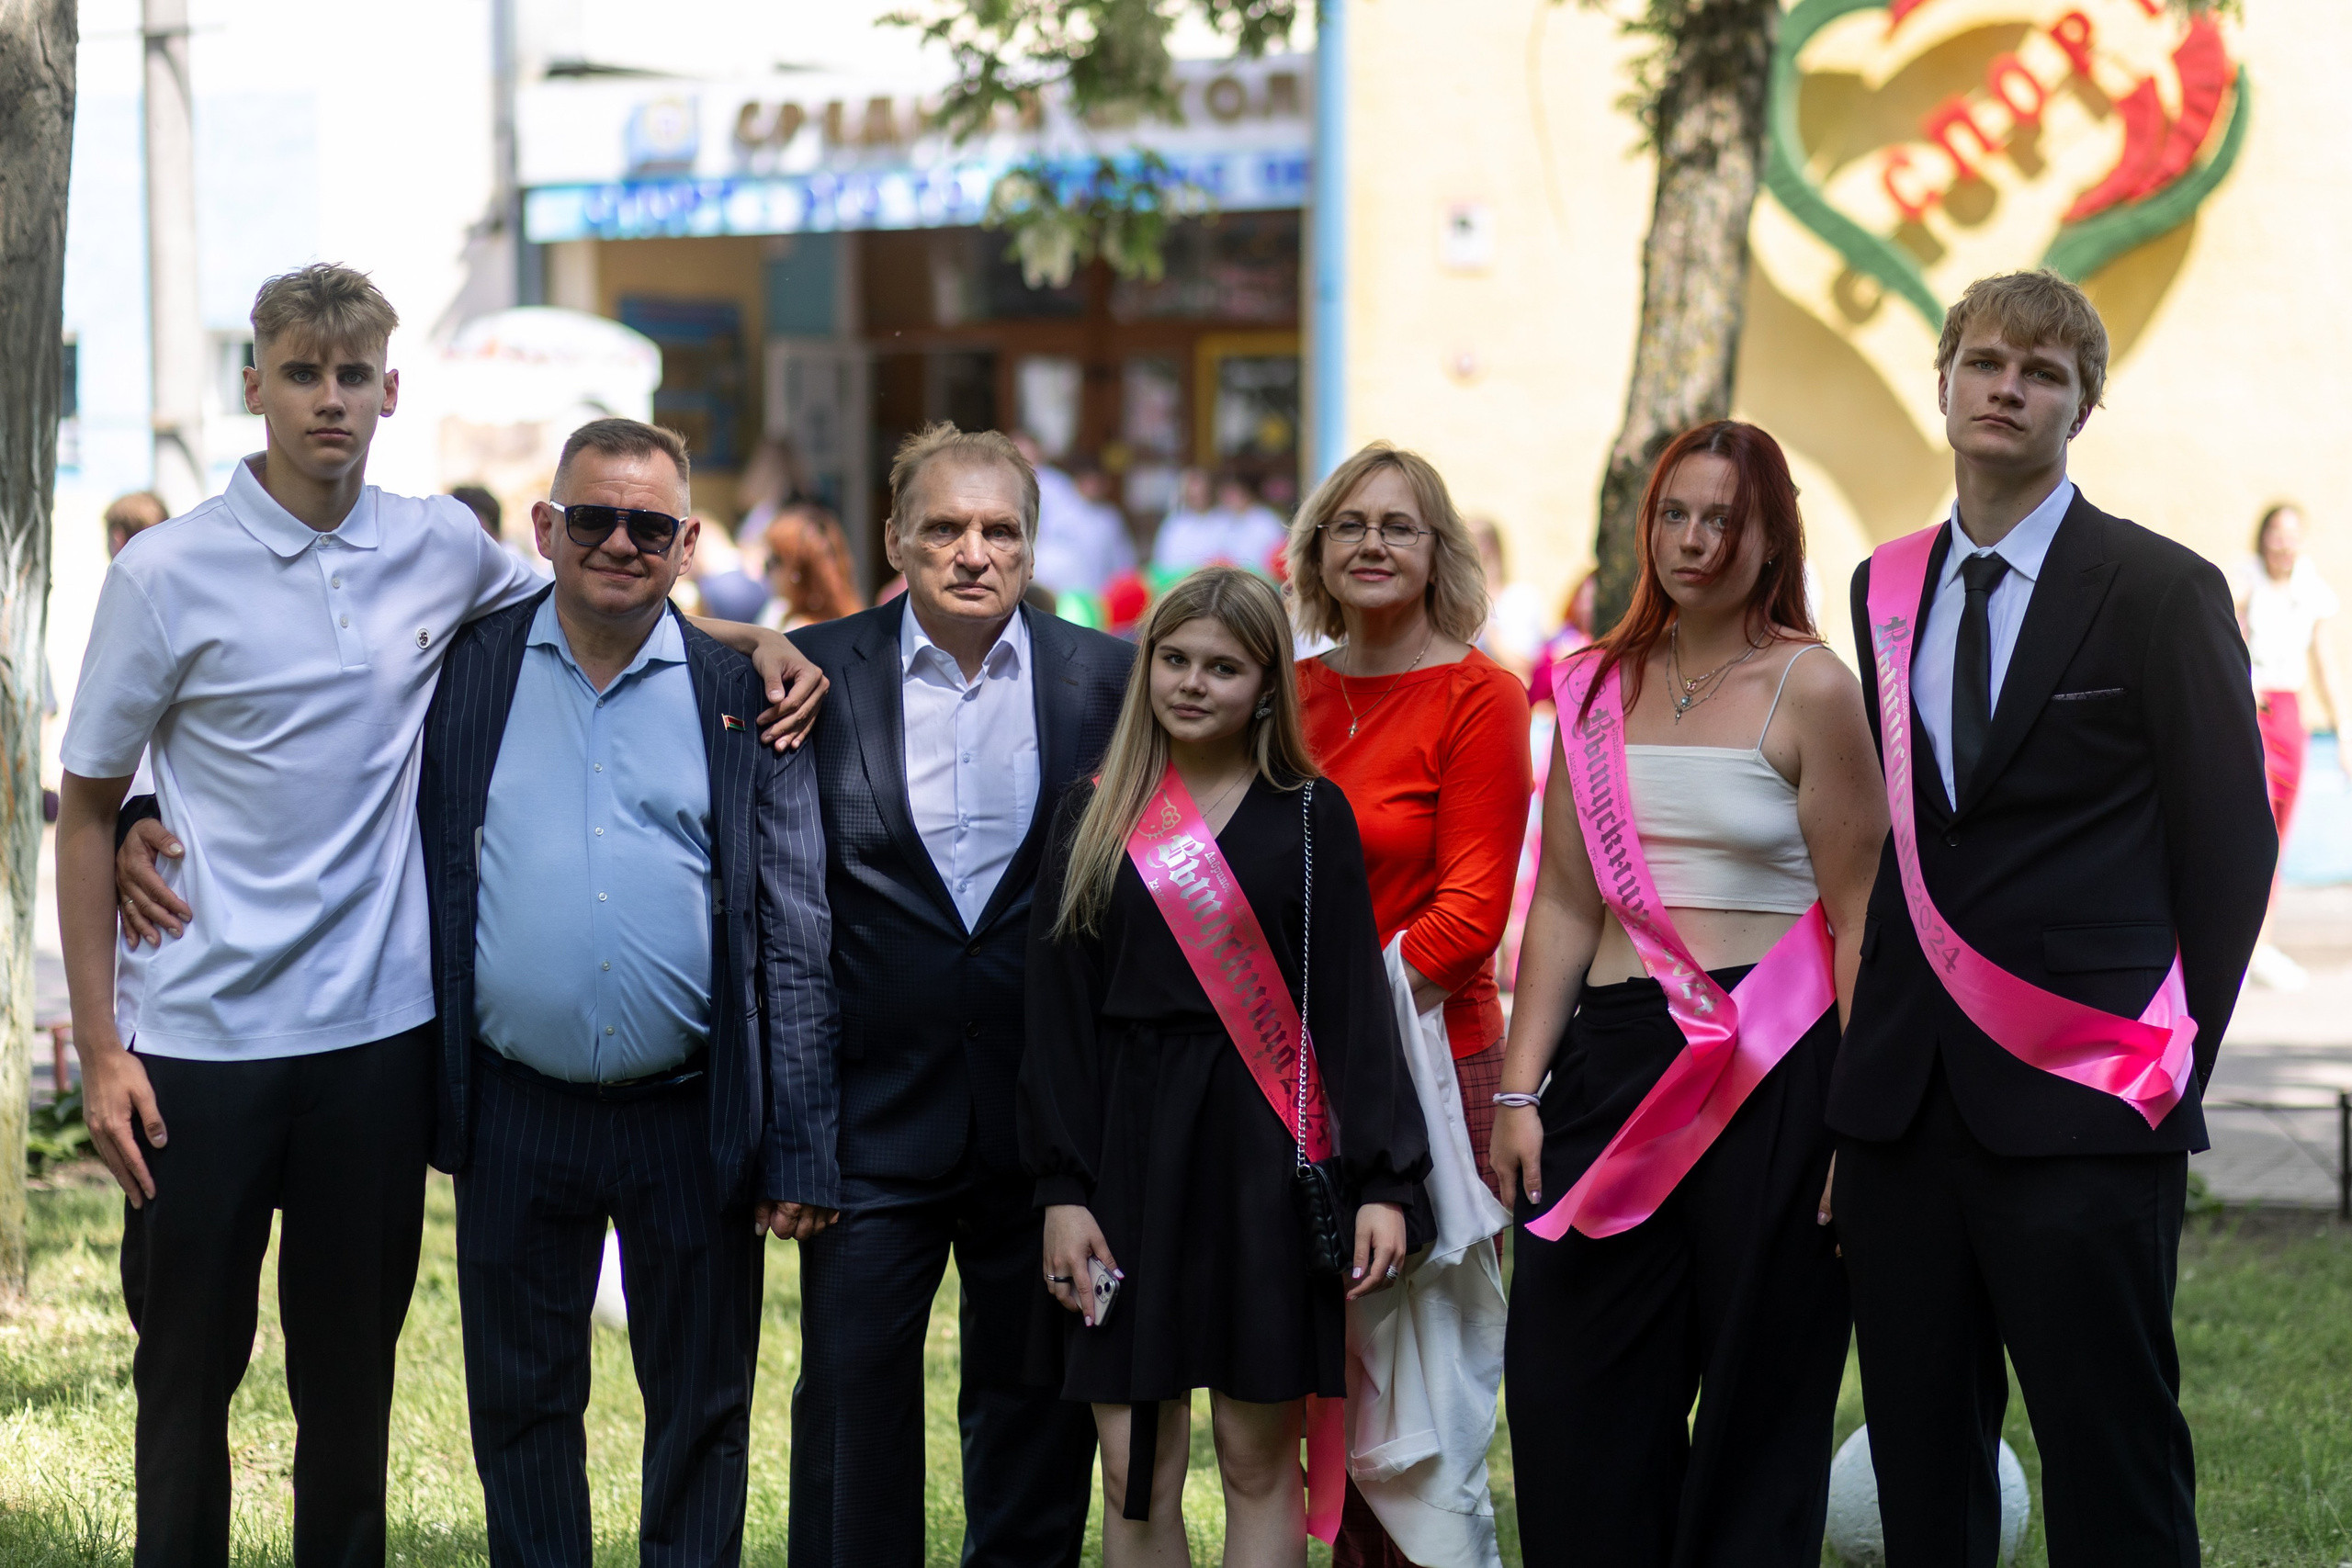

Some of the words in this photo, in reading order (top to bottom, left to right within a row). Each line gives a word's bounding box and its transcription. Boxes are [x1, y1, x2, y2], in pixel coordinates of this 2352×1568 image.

[1883, 0, 2165, 222] СПОР
[1148, 878, 1166, 904] класс
[1572, 705, 1660, 942] Выпускниц
[1911, 882, 1961, 975] 2024
[1146, 830, 1296, 1074] Выпускница
